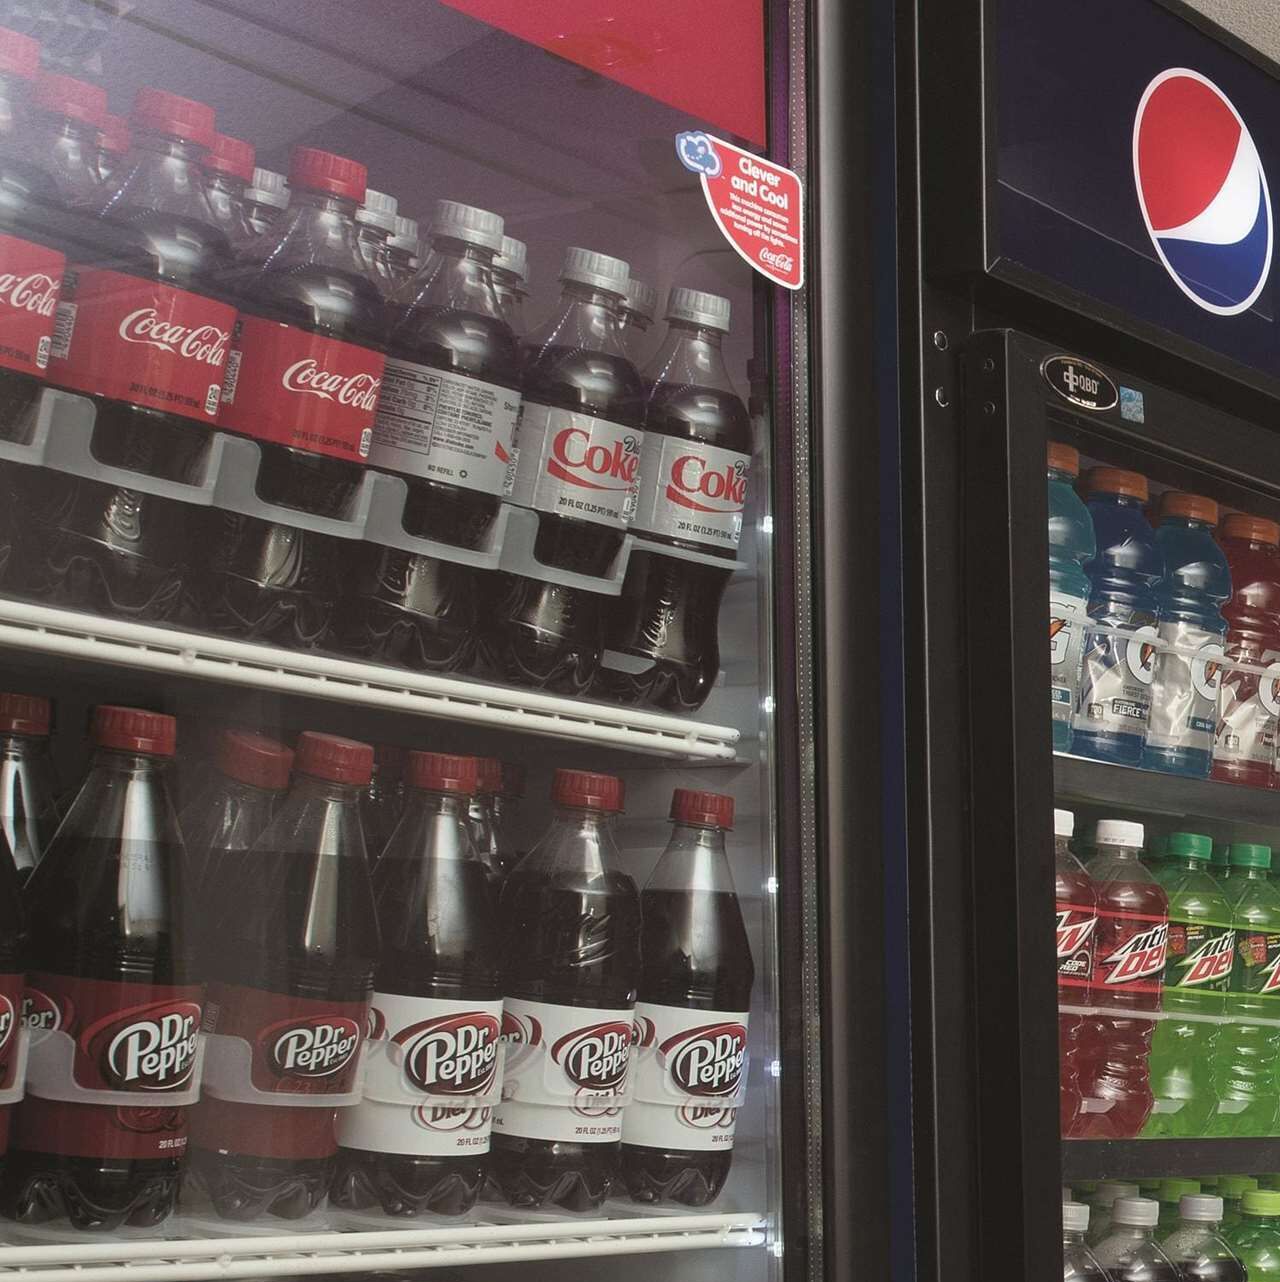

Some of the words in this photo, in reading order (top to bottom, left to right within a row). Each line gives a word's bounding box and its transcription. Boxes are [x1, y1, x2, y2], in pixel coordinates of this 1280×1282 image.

[739, 157, 781, 187] Clever
[731, 175, 757, 196] and
[759, 185, 788, 209] Cool
[119, 307, 230, 367] Coca-Cola
[281, 359, 383, 412] Coca-Cola
[1079, 375, 1098, 395] QBD
[553, 427, 640, 484] Coke
[671, 455, 747, 504] Coke
[1113, 704, 1142, 718] FIERCE
[161, 1014, 194, 1048] Dr
[312, 1025, 344, 1048] Dr
[456, 1025, 489, 1056] Dr
[604, 1032, 626, 1055] Dr
[715, 1035, 741, 1058] Dr
[275, 1029, 356, 1071] Pepper
